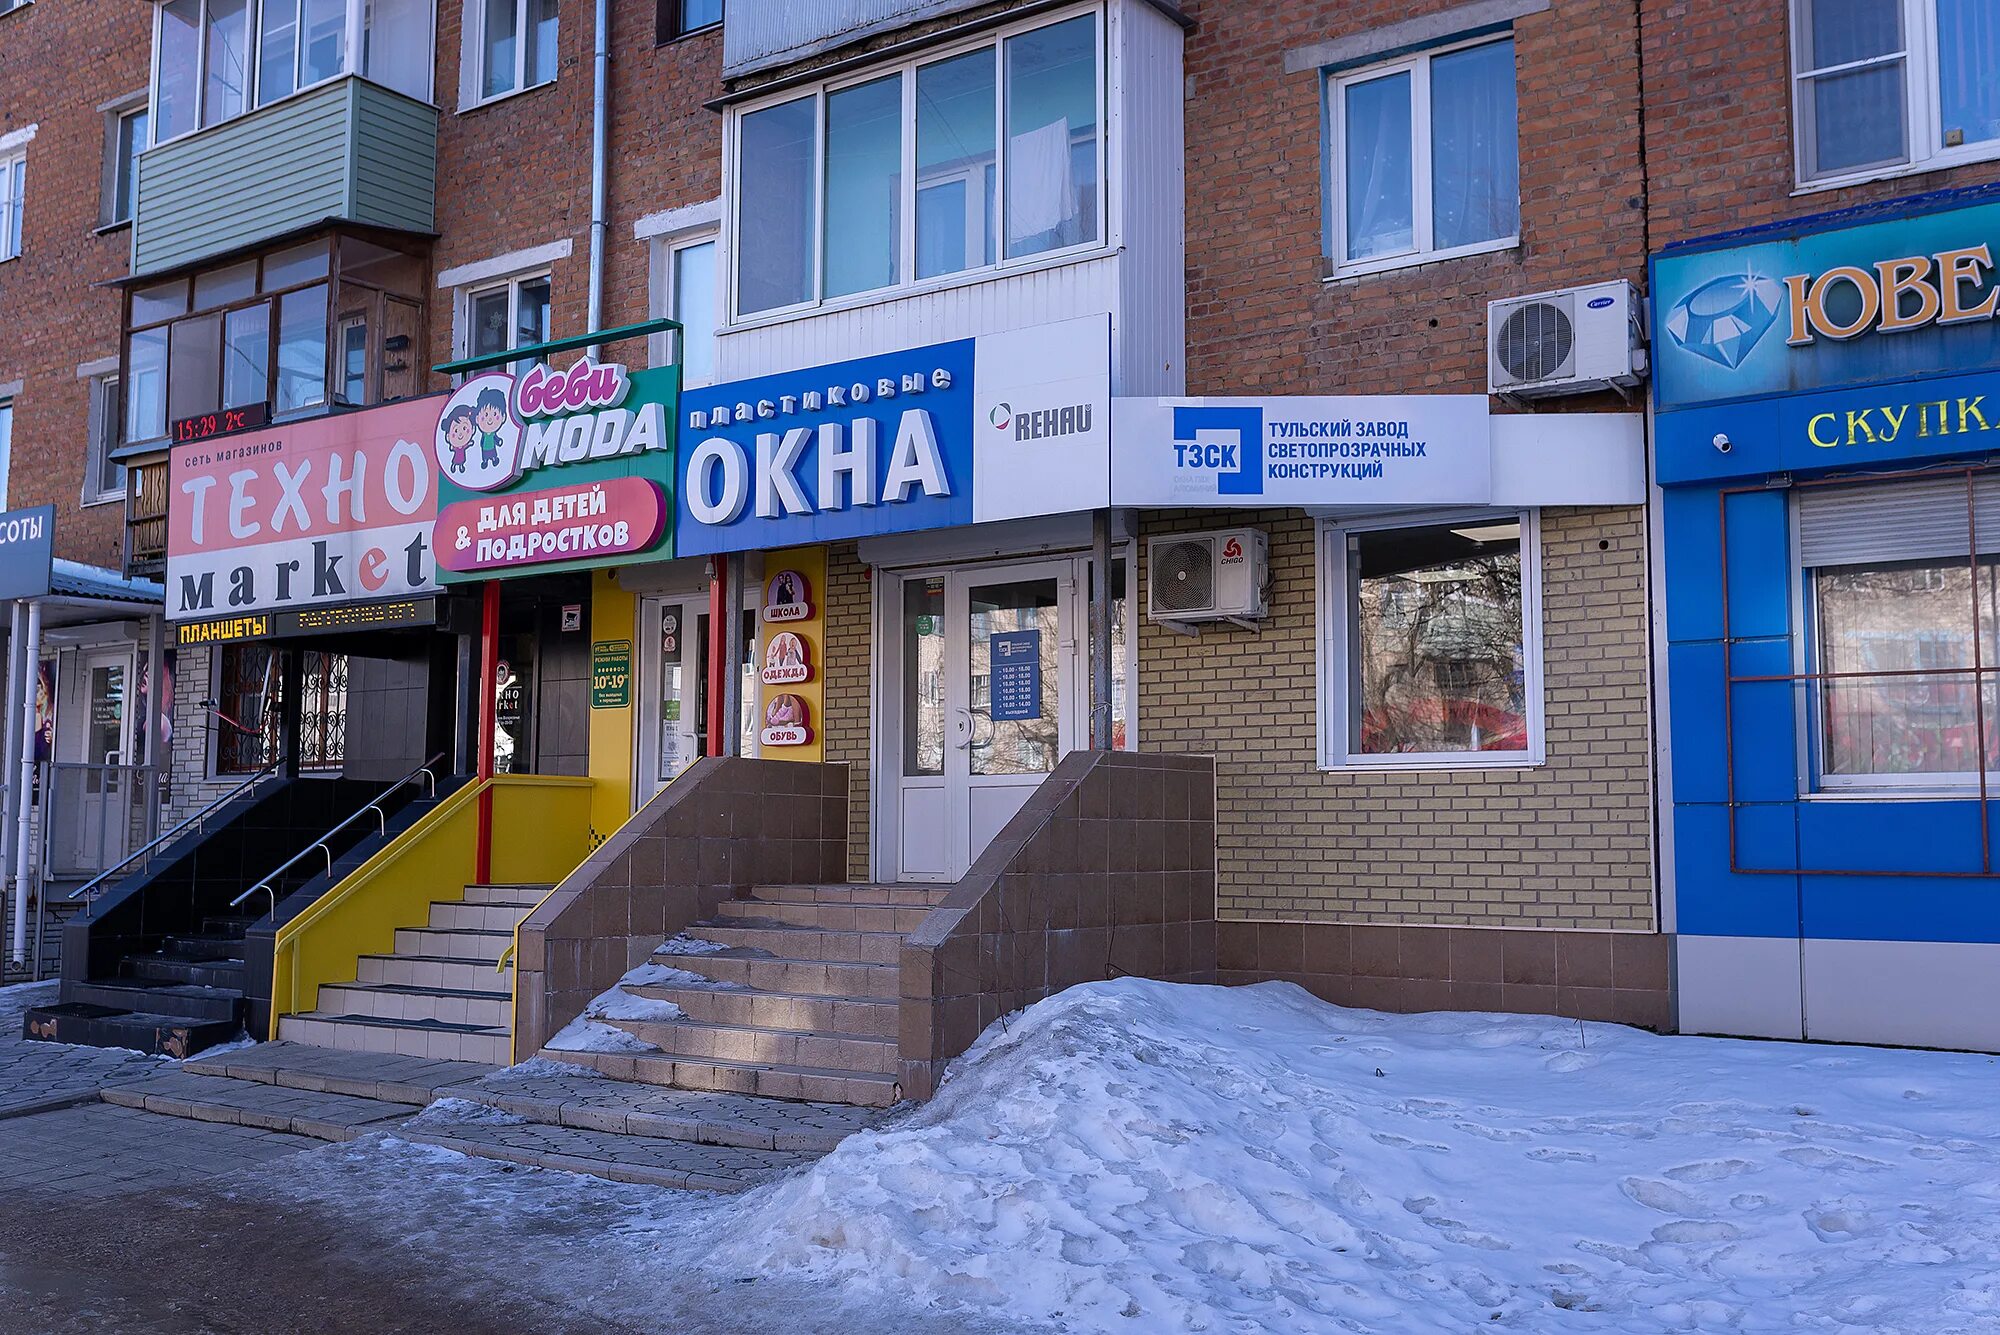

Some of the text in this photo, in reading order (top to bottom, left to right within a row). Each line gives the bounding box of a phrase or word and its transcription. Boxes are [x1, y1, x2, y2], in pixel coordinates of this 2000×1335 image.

[1783, 242, 2000, 347] ЮВЕ
[690, 368, 952, 430] пластиковые
[178, 415, 217, 441] 15:29
[1015, 403, 1092, 442] REHAU
[1269, 418, 1409, 440] ТУЛЬСКИЙ ЗАВОД
[1807, 395, 2000, 448] СКУПК
[185, 440, 283, 468] сеть магазинов
[1173, 444, 1237, 468] ТЗСК
[1268, 441, 1427, 459] СВЕТОПРОЗРАЧНЫХ
[686, 409, 951, 526] ОКНА
[1268, 460, 1383, 481] КОНСТРУКЦИЙ
[182, 439, 430, 545] ТЕХНО
[477, 484, 606, 533] ДЛЯ ДЕТЕЙ
[455, 521, 630, 562] & ПОДРОСТКОВ
[1221, 557, 1244, 565] CHIGO
[770, 605, 800, 619] ШКОЛА
[180, 615, 267, 644] ПЛАНШЕТЫ
[763, 667, 805, 680] ОДЕЖДА
[770, 730, 797, 741] ОБУВЬ
